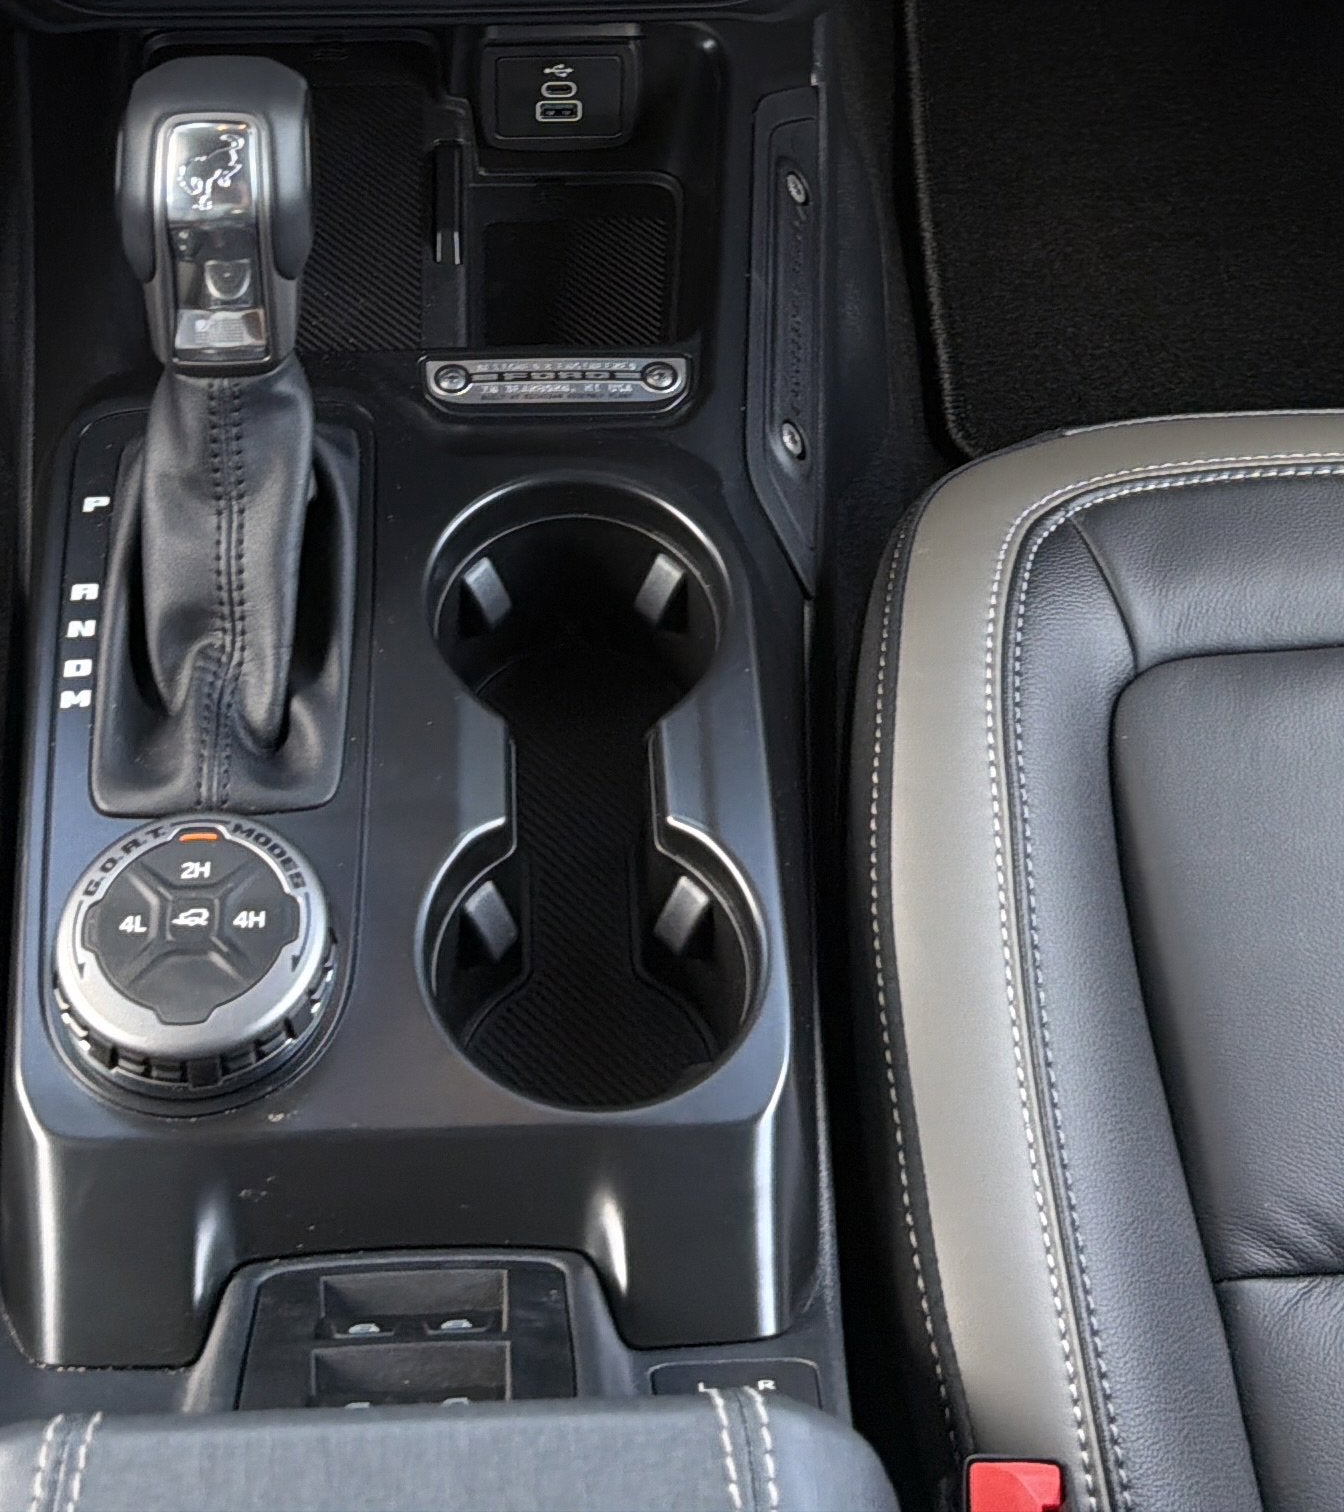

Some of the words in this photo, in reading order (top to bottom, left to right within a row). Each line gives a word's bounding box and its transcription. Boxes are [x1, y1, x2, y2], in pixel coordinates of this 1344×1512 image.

[81, 495, 112, 514] P
[66, 619, 97, 638] N
[62, 658, 93, 678] D
[58, 689, 93, 709] M
[231, 822, 308, 890] MODES
[179, 861, 212, 880] 2H
[118, 914, 148, 934] 4L
[232, 910, 267, 930] 4H
[757, 1379, 776, 1391] R
